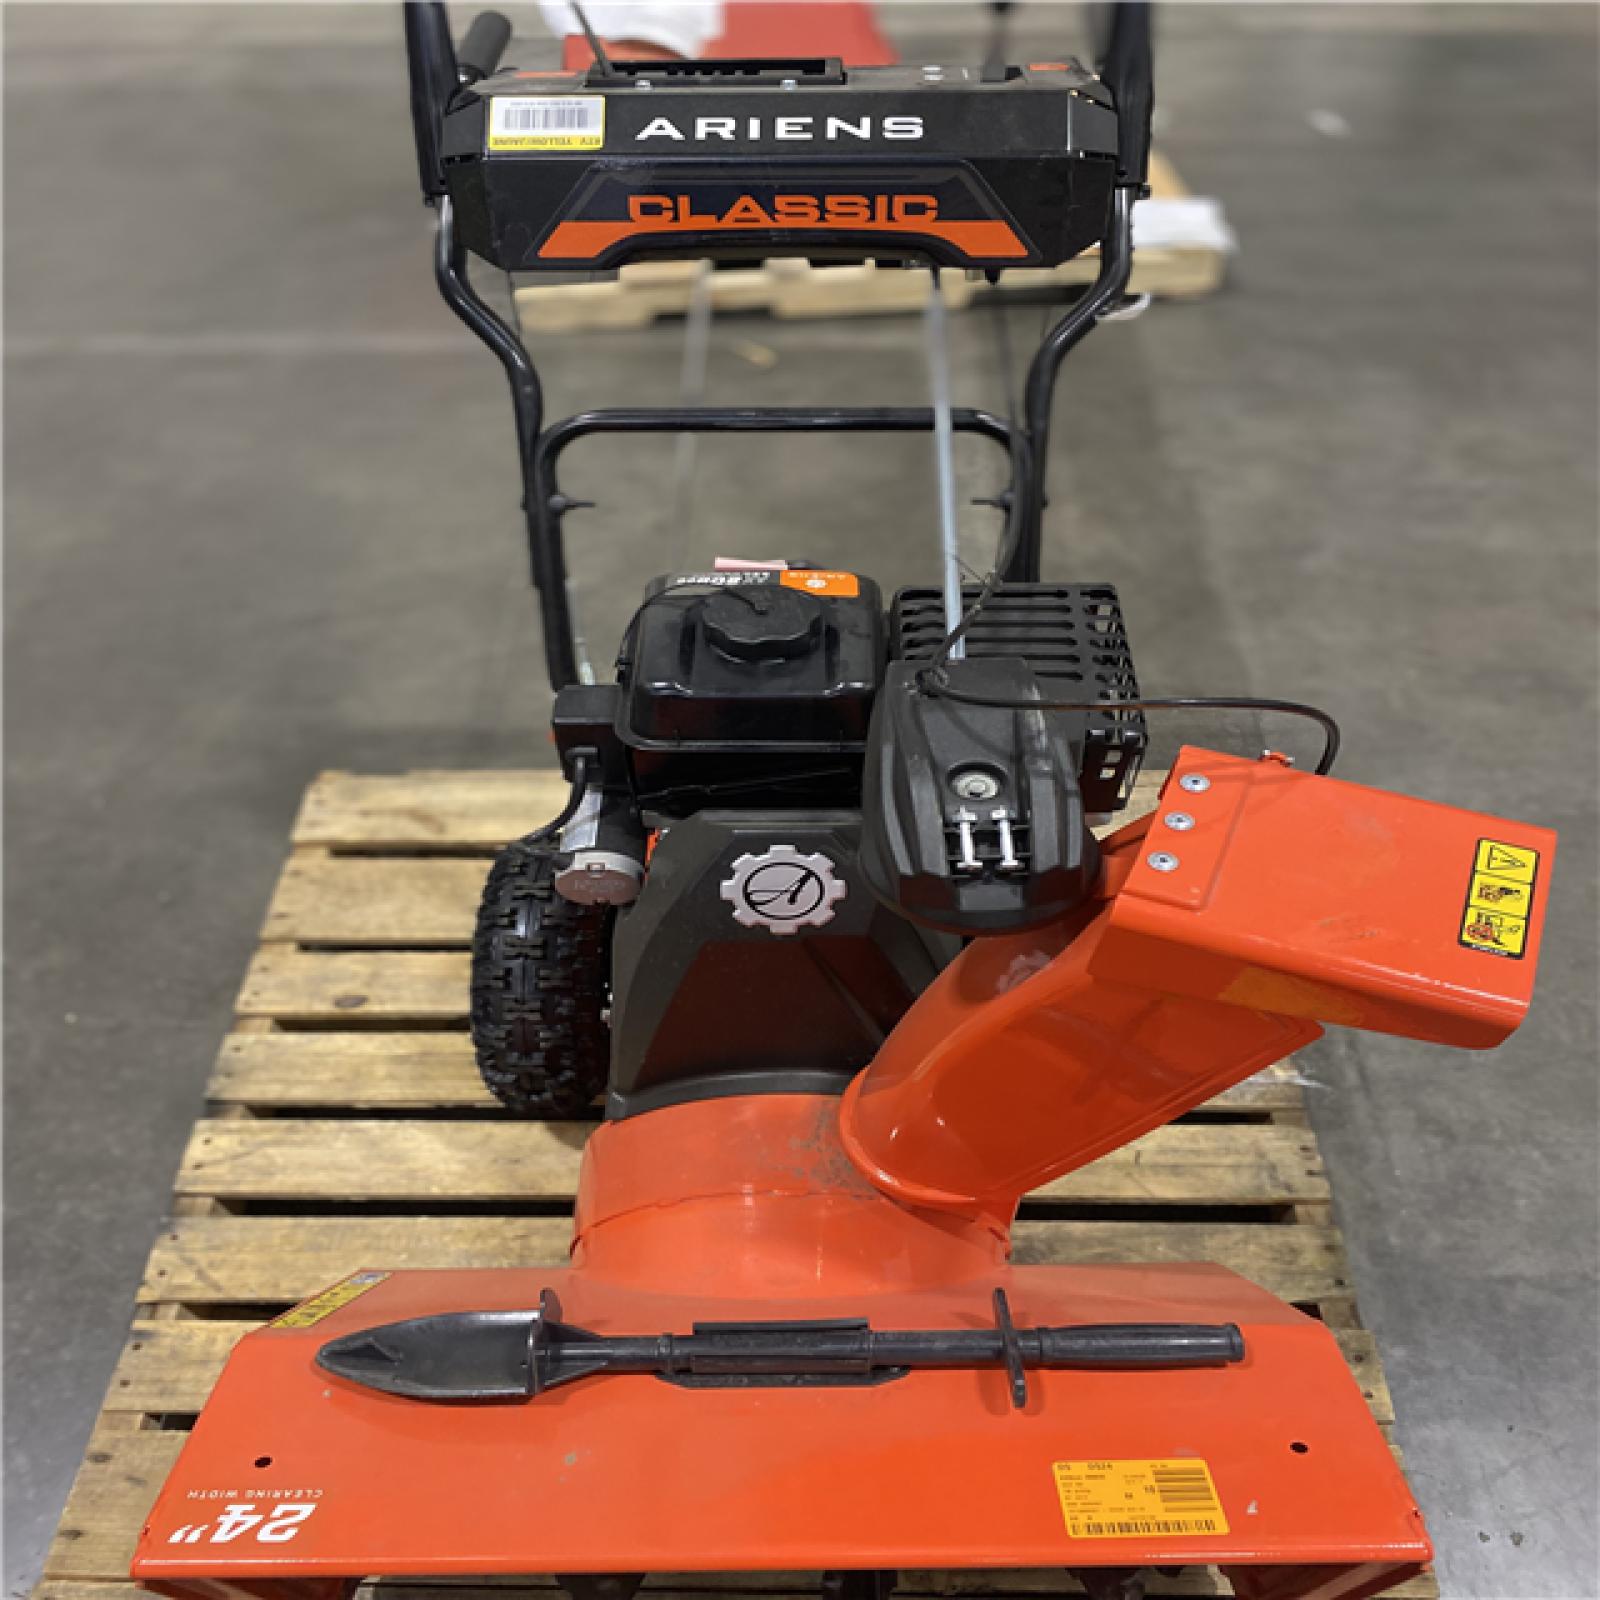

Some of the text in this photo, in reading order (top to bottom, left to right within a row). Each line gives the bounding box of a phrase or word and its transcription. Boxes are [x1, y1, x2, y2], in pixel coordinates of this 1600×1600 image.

[635, 117, 924, 141] ARIENS
[628, 195, 939, 223] CLASSIC
[186, 1488, 324, 1500] CLEARING WIDTH
